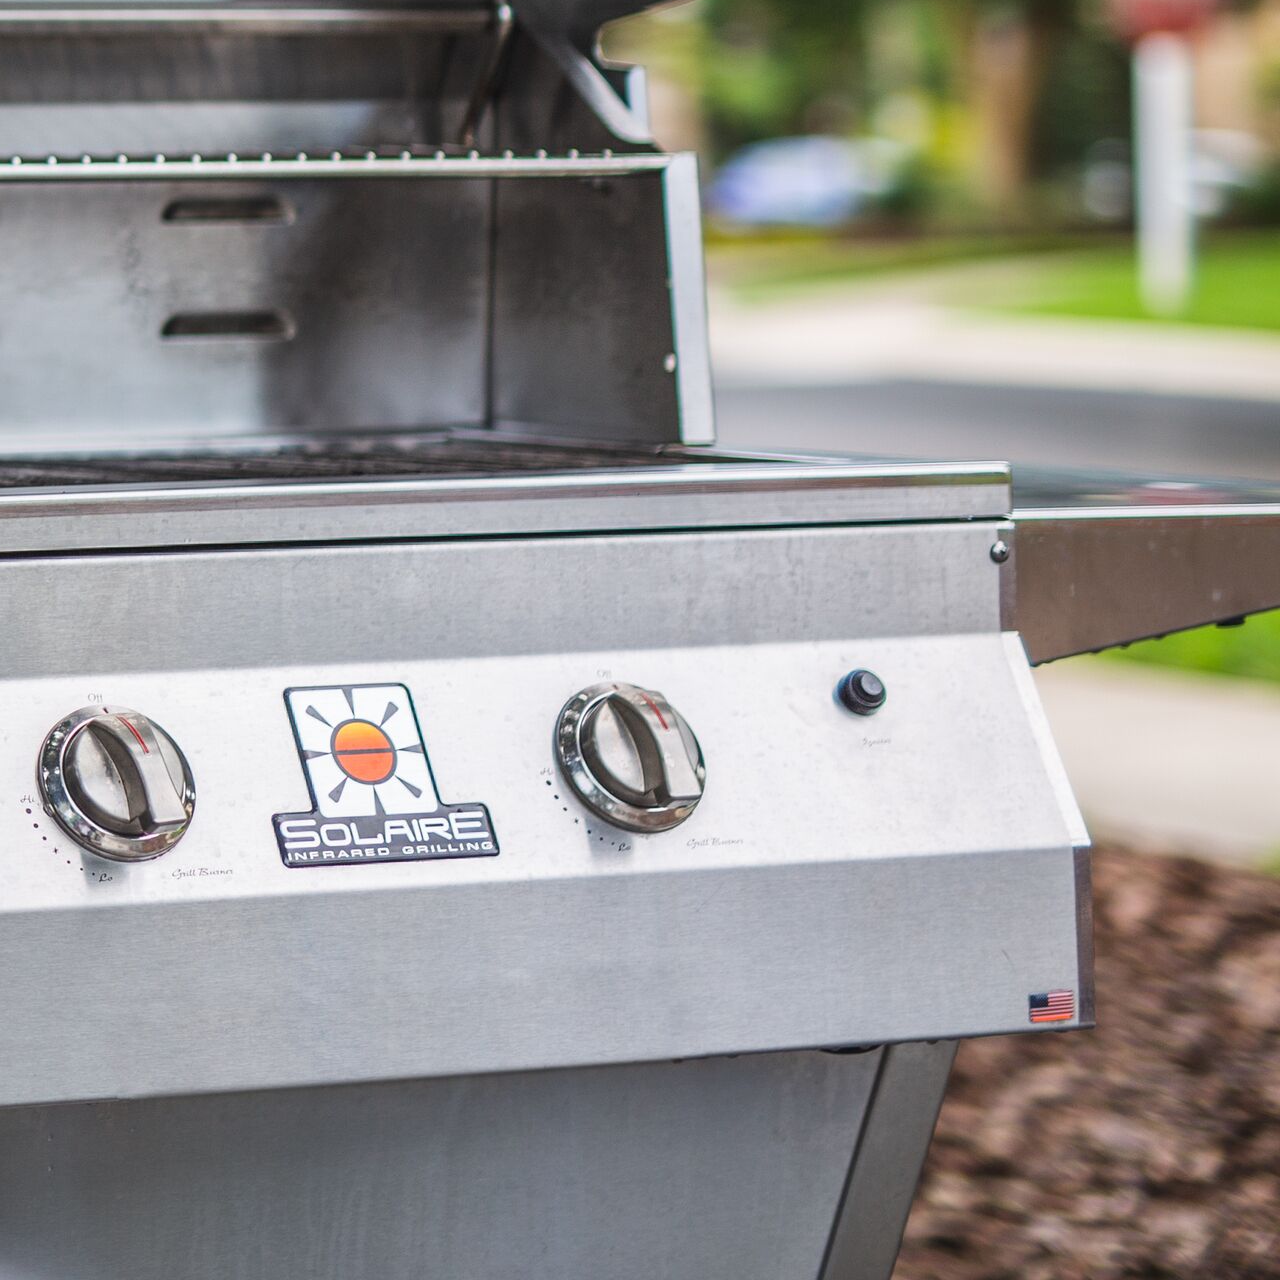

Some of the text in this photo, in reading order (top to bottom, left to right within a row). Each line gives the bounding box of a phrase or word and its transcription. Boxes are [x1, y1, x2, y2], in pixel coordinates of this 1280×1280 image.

[279, 811, 490, 850] SOLAIRE
[287, 841, 494, 861] INFRARED GRILLING
